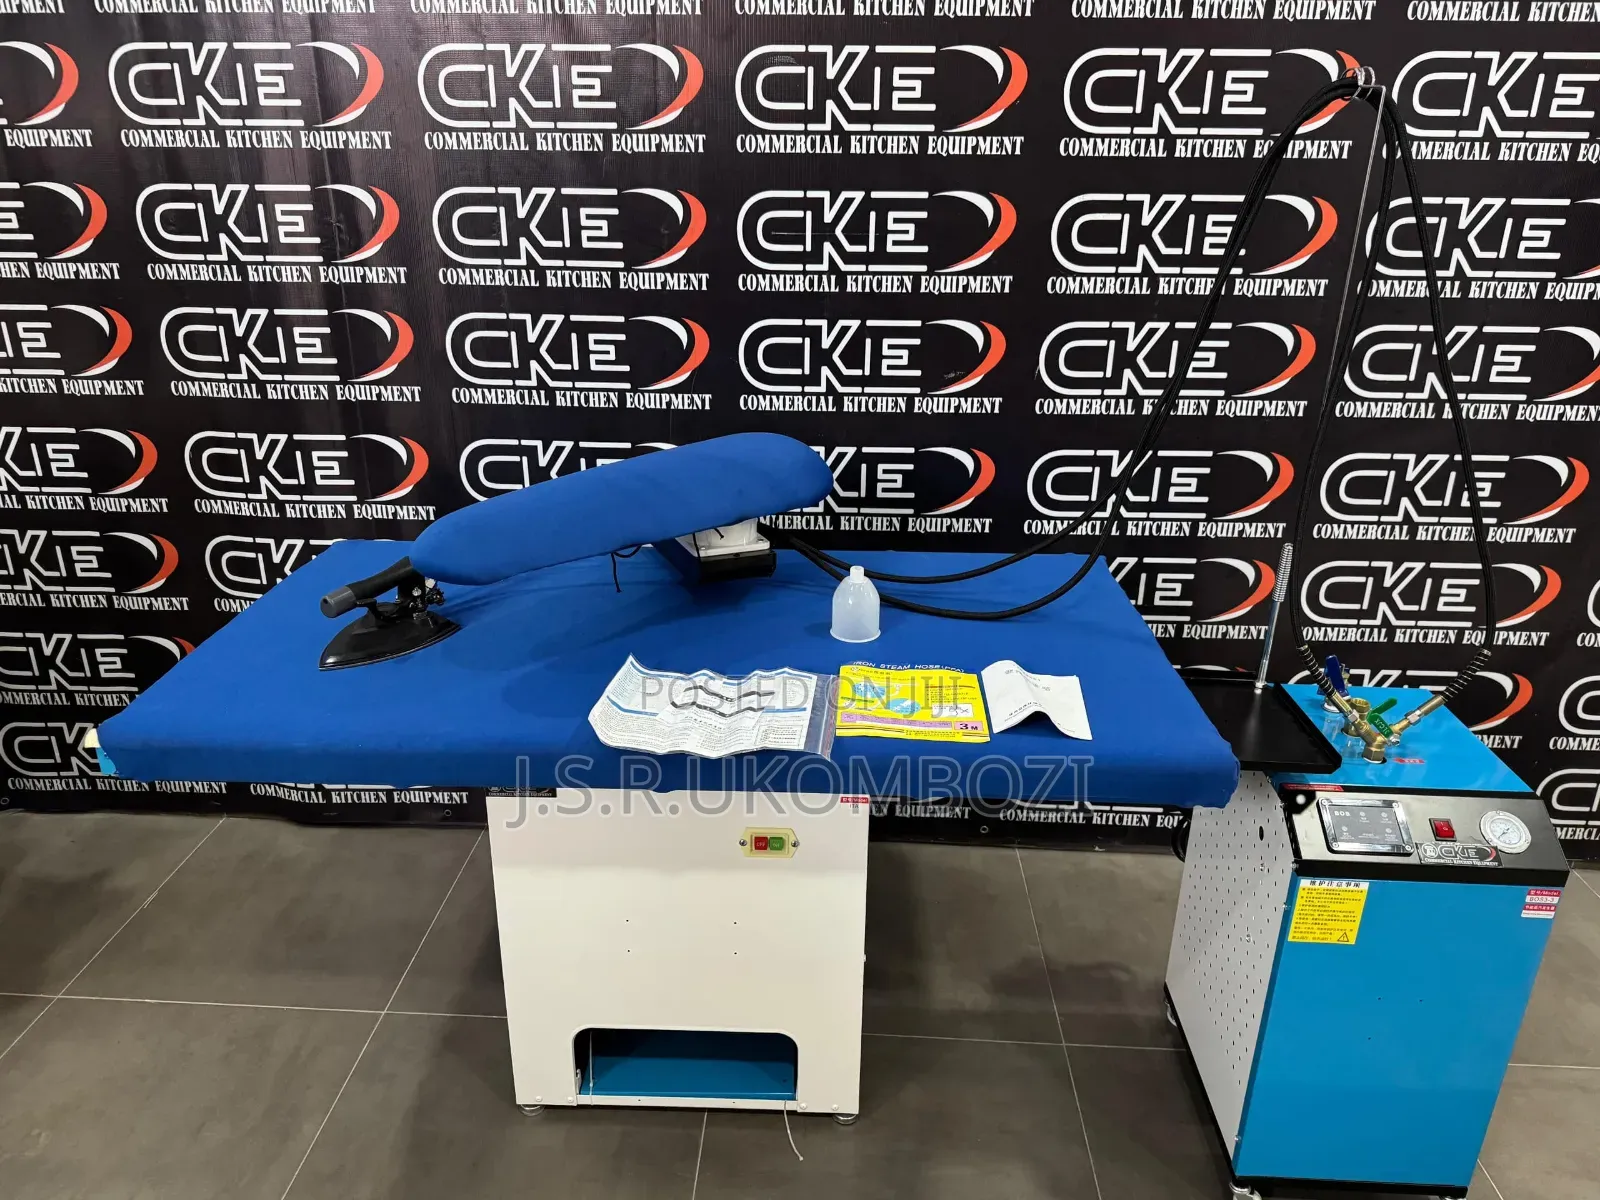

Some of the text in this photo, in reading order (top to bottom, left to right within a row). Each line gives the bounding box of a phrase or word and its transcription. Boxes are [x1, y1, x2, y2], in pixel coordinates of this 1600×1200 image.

[94, 0, 375, 14] COMMERCIAL KITCHEN EQUIPMENT
[411, 0, 701, 15] COMMERCIAL KITCHEN EQUIPMENT
[735, 0, 1034, 18] COMMERCIAL KITCHEN EQUIPMENT
[1072, 0, 1376, 21] COMMERCIAL KITCHEN EQUIPMENT
[1407, 1, 1520, 21] COMMERCIAL
[108, 42, 304, 126] CKE
[418, 43, 618, 128] CKE
[735, 45, 936, 132] CKE
[1064, 48, 1272, 135] CKE
[1393, 50, 1600, 137] CKE
[4, 129, 92, 148] EQUIPMENT
[121, 129, 392, 151] COMMERCIAL KITCHEN EQUIPMENT
[424, 132, 706, 154] COMMERCIAL KITCHEN EQUIPMENT
[736, 134, 1024, 156] COMMERCIAL KITCHEN EQUIPMENT
[1060, 138, 1167, 157] COMMERCIAL
[1174, 139, 1246, 158] KITCHEN
[1498, 142, 1572, 161] KITCHEN
[135, 182, 323, 262] CKE
[432, 187, 624, 267] CKE
[737, 190, 929, 272] CKE
[1051, 193, 1246, 274] CKE
[1365, 197, 1571, 278] CKE
[35, 262, 120, 280] EQUIPMENT
[147, 264, 407, 284] COMMERCIAL KITCHEN EQUIPMENT
[439, 268, 709, 291] COMMERCIAL KITCHEN EQUIPMENT
[738, 274, 1013, 295] COMMERCIAL KITCHEN EQUIPMENT
[1047, 277, 1150, 294] COMMERCIAL
[1233, 278, 1328, 297] EQUIPMENT
[1468, 281, 1539, 299] KITCHEN
[160, 307, 340, 381] CKE
[446, 312, 631, 388] CKE
[738, 318, 921, 393] CKE
[1039, 321, 1232, 396] CKE
[1344, 324, 1541, 399] CKE
[62, 379, 144, 396] EQUIPMENT
[171, 381, 421, 402] COMMERCIAL KITCHEN EQUIPMENT
[452, 388, 712, 410] COMMERCIAL KITCHEN EQUIPMENT
[740, 395, 1002, 414] COMMERCIAL KITCHEN EQUIPMENT
[1035, 399, 1135, 415] COMMERCIAL
[1216, 400, 1307, 417] EQUIPMENT
[1335, 401, 1435, 418] COMMERCIAL
[185, 431, 357, 501] CKE
[1026, 450, 1213, 518] CKE
[1320, 452, 1510, 524] CKE
[26, 495, 84, 509] KITCHEN
[90, 497, 168, 512] EQUIPMENT
[195, 499, 435, 520] COMMERCIAL KITCHEN EQUIPMENT
[841, 516, 900, 531] KITCHEN
[908, 518, 992, 533] EQUIPMENT
[1126, 521, 1191, 536] KITCHEN
[1197, 522, 1286, 538] EQUIPMENT
[1313, 524, 1409, 540] COMMERCIAL
[1486, 527, 1576, 543] EQUIPMENT
[51, 594, 107, 607] KITCHEN
[114, 596, 188, 610] EQUIPMENT
[1300, 560, 1482, 627] CKE
[1182, 624, 1268, 639] EQUIPMENT
[1394, 629, 1458, 644] KITCHEN
[75, 693, 130, 707] KITCHEN
[959, 722, 969, 730] 3
[8, 778, 226, 793] COMMERCIAL KITCHEN EQUIPMENT
[250, 782, 468, 804] COMMERCIAL KITCHEN EQUIPMENT
[895, 804, 971, 820] EQUIPMENT
[999, 809, 1085, 823] COMMERCIAL
[1092, 812, 1150, 826] KITCHEN
